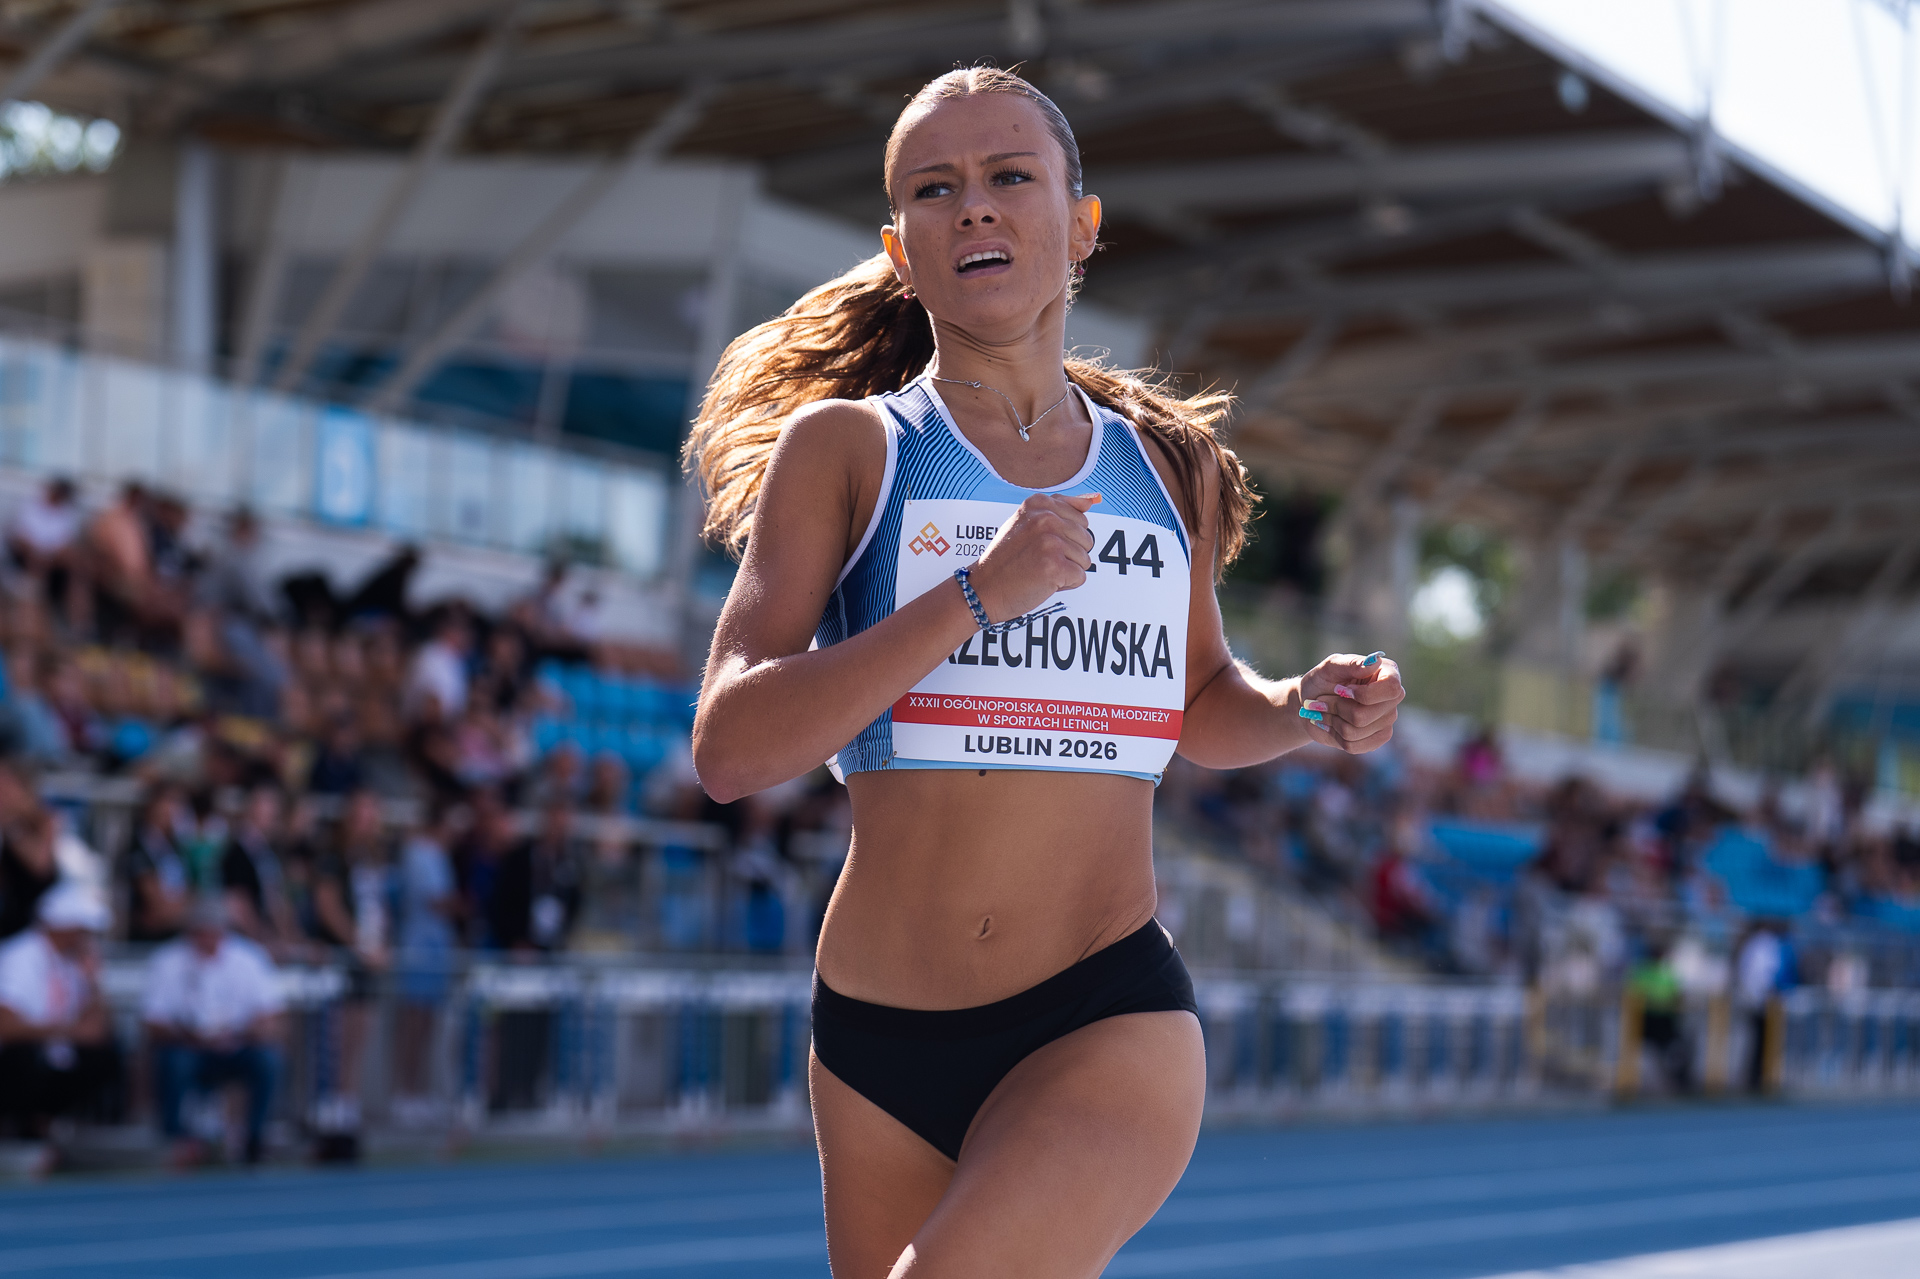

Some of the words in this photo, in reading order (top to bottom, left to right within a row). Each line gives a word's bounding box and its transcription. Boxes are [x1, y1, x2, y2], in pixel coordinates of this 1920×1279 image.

[955, 543, 986, 557] 2026
[948, 614, 1174, 680] ZECHOWSKA
[909, 696, 940, 708] XXXII
[943, 697, 1044, 714] OGÓLNOPOLSKA
[1046, 704, 1109, 718] OLIMPIADA
[1111, 708, 1170, 723] MŁODZIEŻY
[977, 714, 991, 725] W
[993, 714, 1060, 728] SPORTACH
[1063, 718, 1109, 731] LETNICH
[964, 734, 1052, 757] LUBLIN
[1059, 738, 1117, 760] 2026
